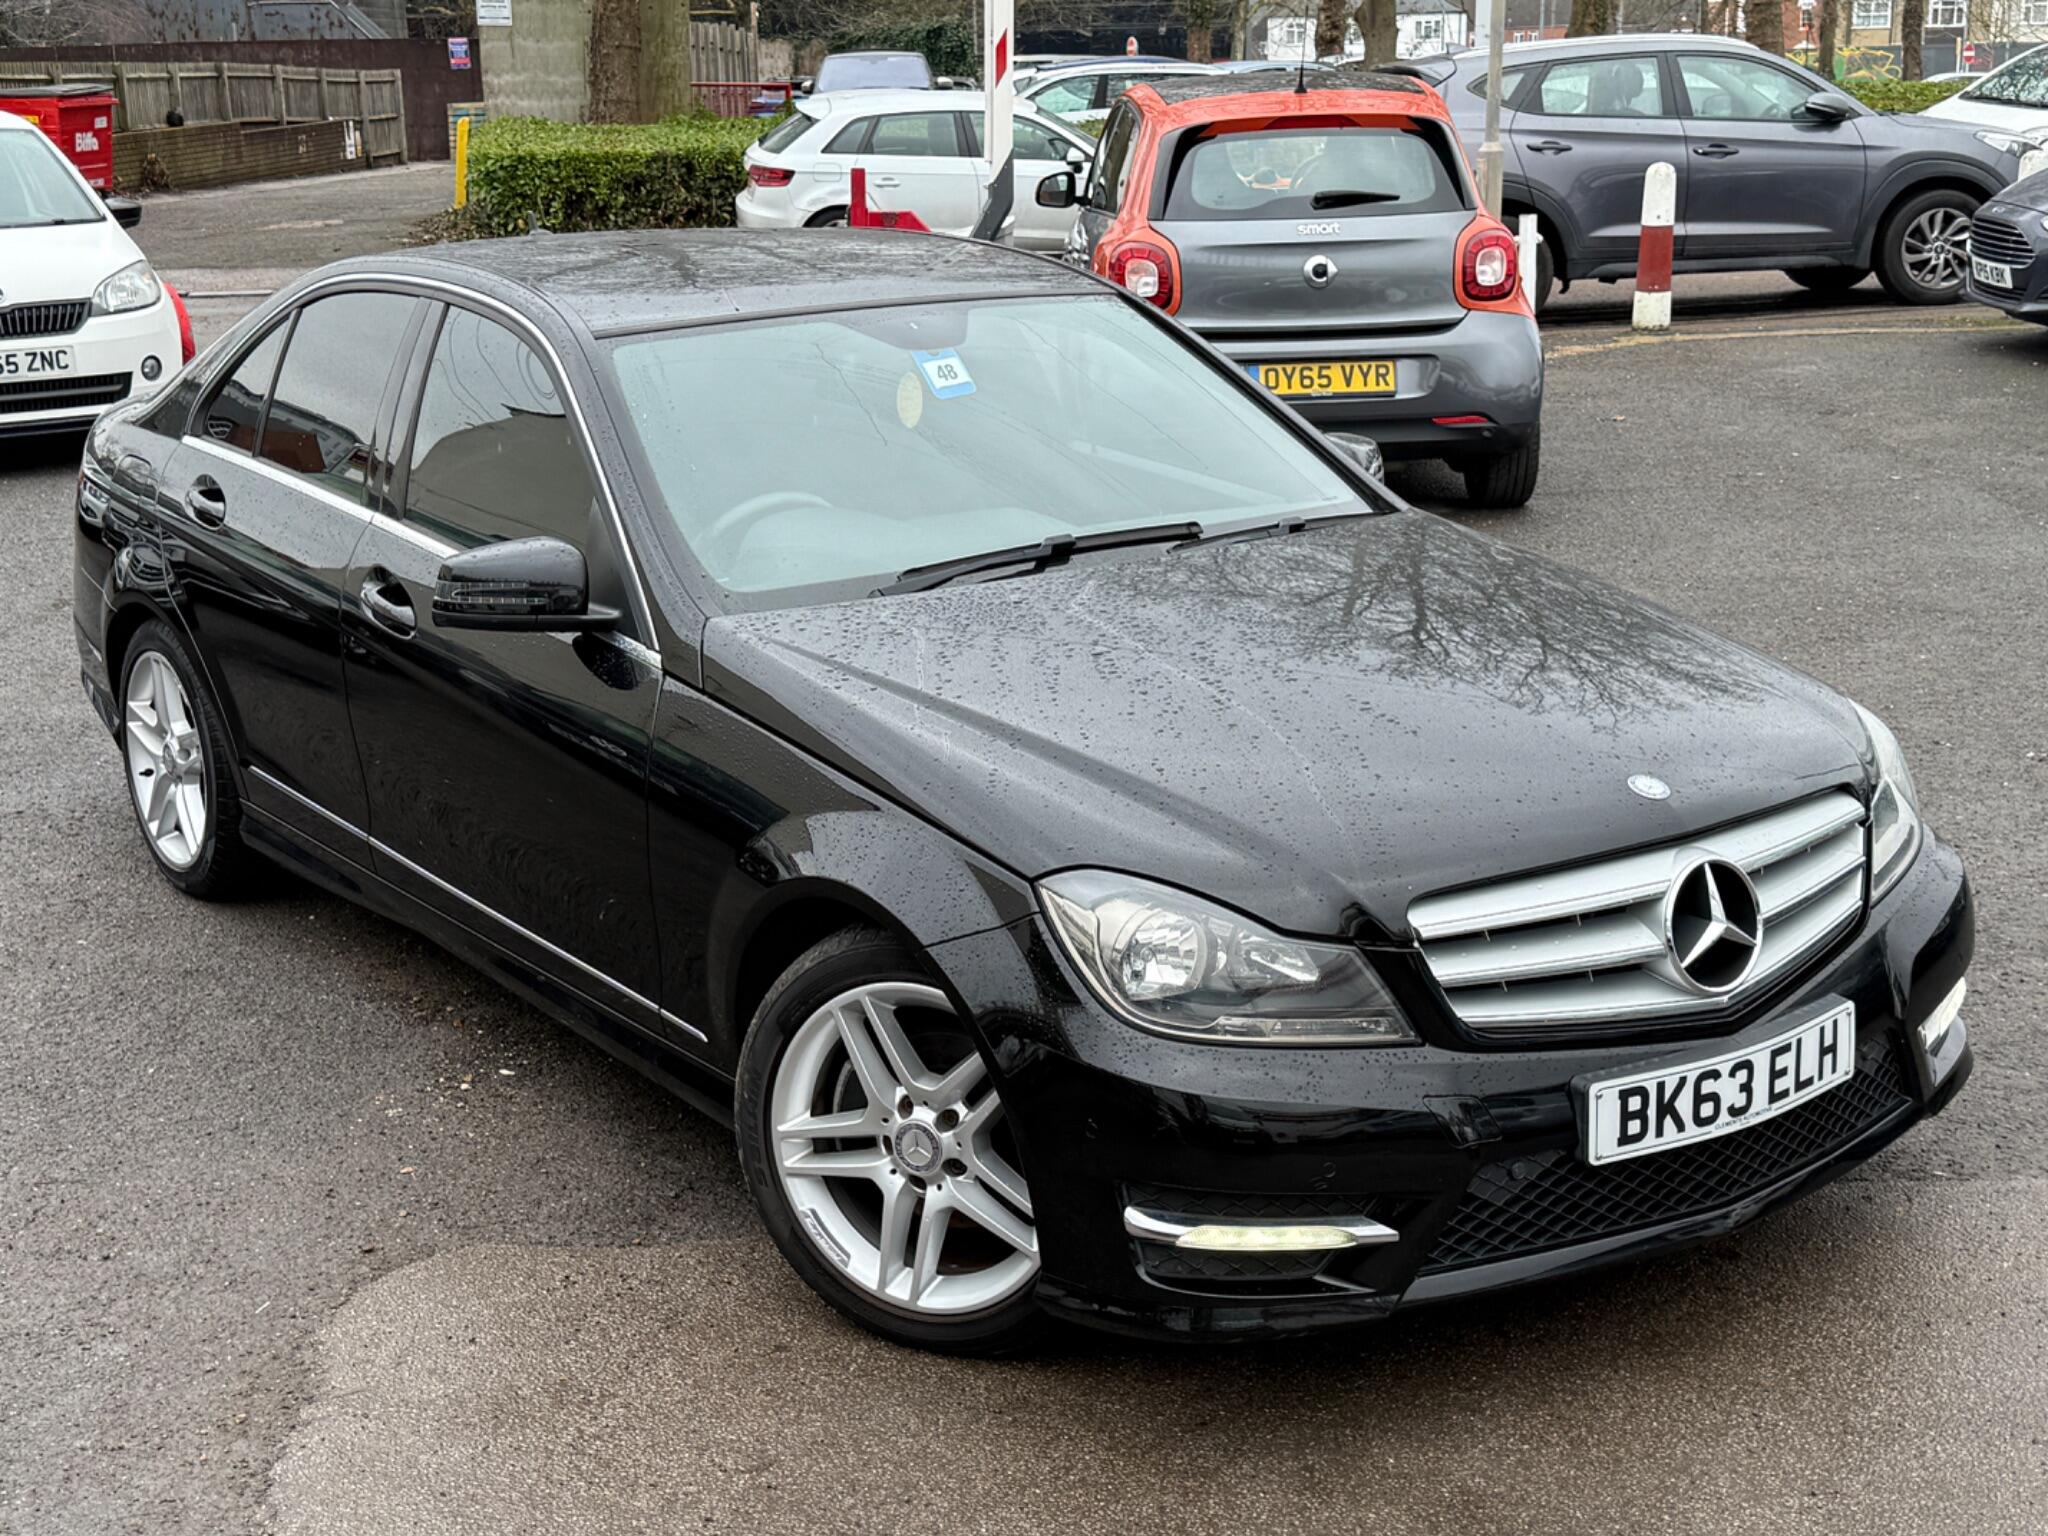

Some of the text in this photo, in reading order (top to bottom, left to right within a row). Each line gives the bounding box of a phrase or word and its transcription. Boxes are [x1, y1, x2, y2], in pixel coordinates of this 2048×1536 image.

[75, 131, 99, 152] Biffa
[1297, 222, 1341, 235] smart
[24, 350, 69, 372] ZNC
[937, 364, 958, 381] 48
[1264, 364, 1390, 390] OY65 VYR
[1617, 1018, 1838, 1147] BK63 ELH
